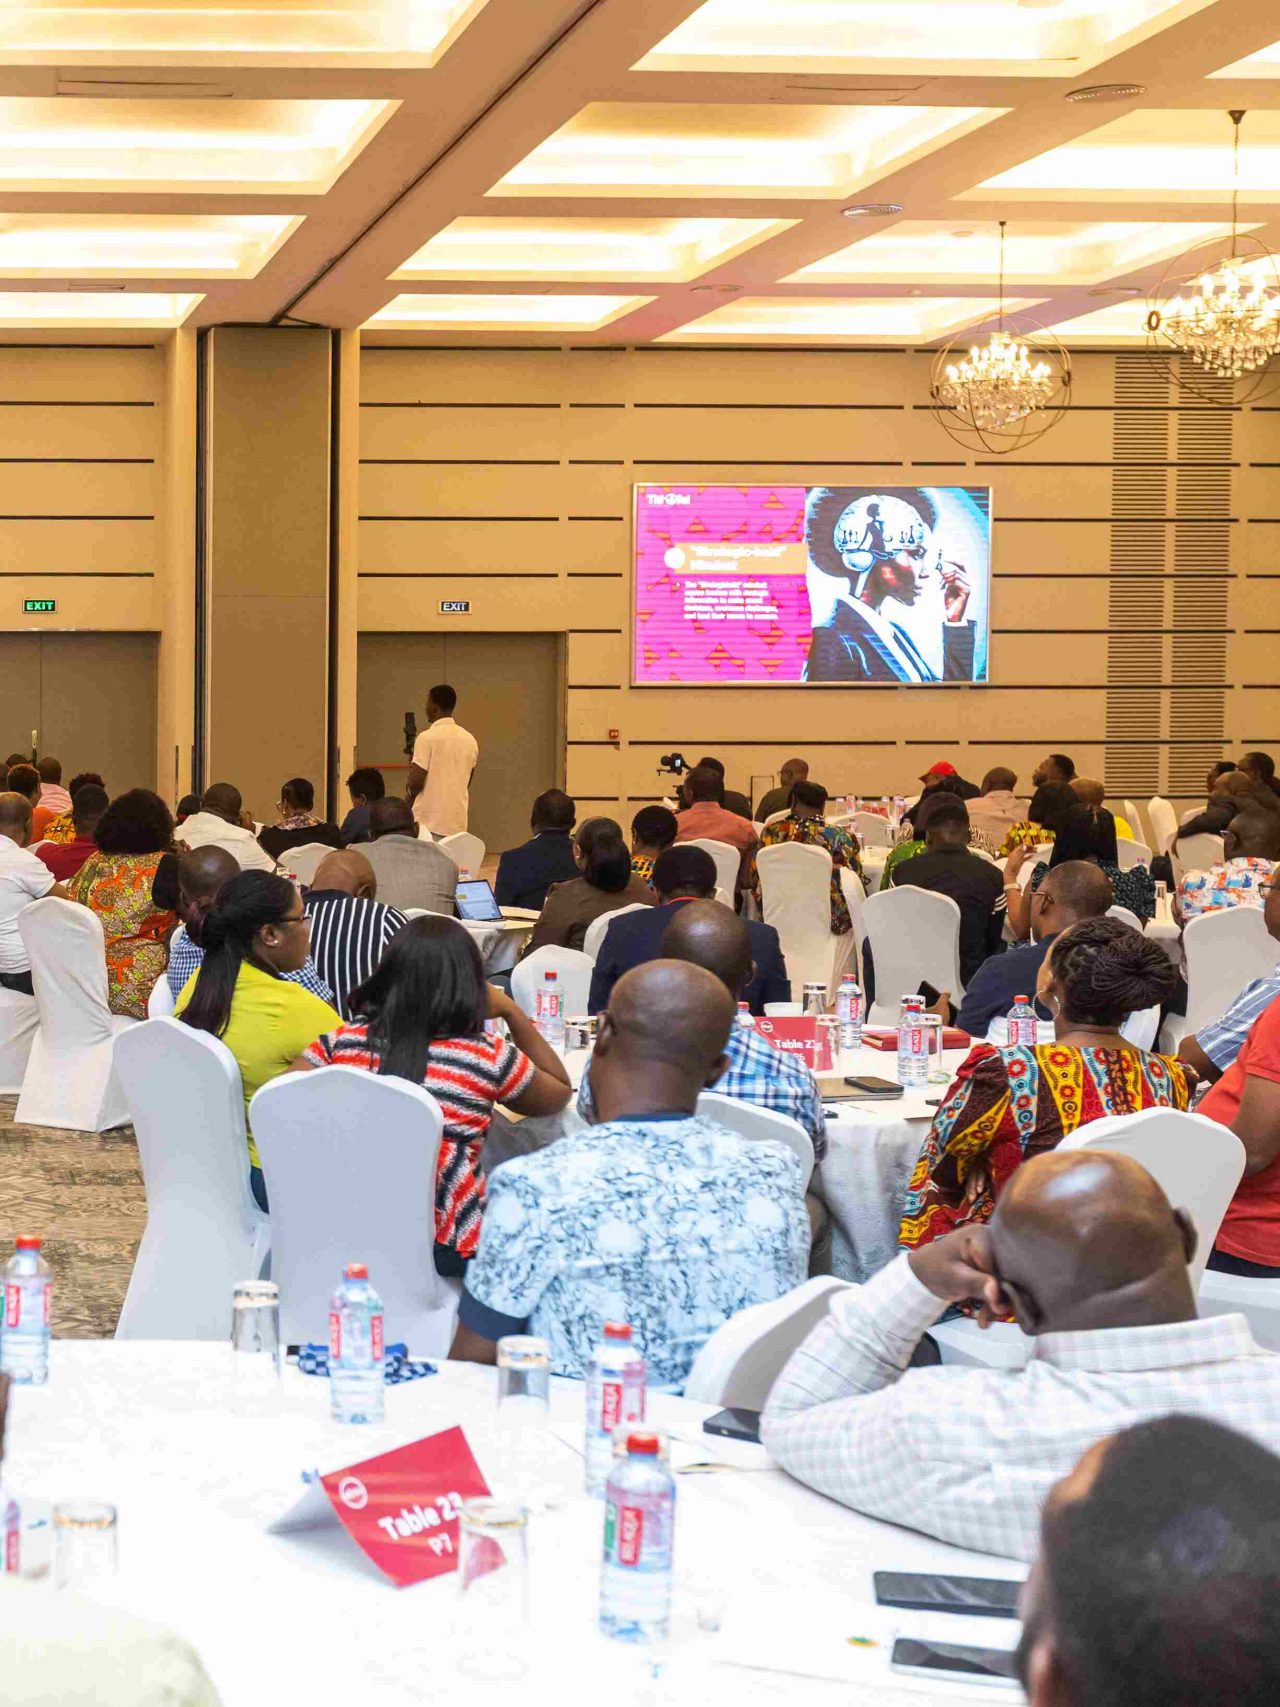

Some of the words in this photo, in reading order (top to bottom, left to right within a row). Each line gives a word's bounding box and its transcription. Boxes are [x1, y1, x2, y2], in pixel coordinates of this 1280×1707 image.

[26, 601, 54, 610] EXIT
[443, 602, 467, 611] EXIT
[773, 1039, 804, 1049] Table
[377, 1504, 441, 1541] Table
[435, 1491, 464, 1522] 23
[621, 1508, 637, 1562] BELAQUA
[427, 1532, 454, 1557] P7
